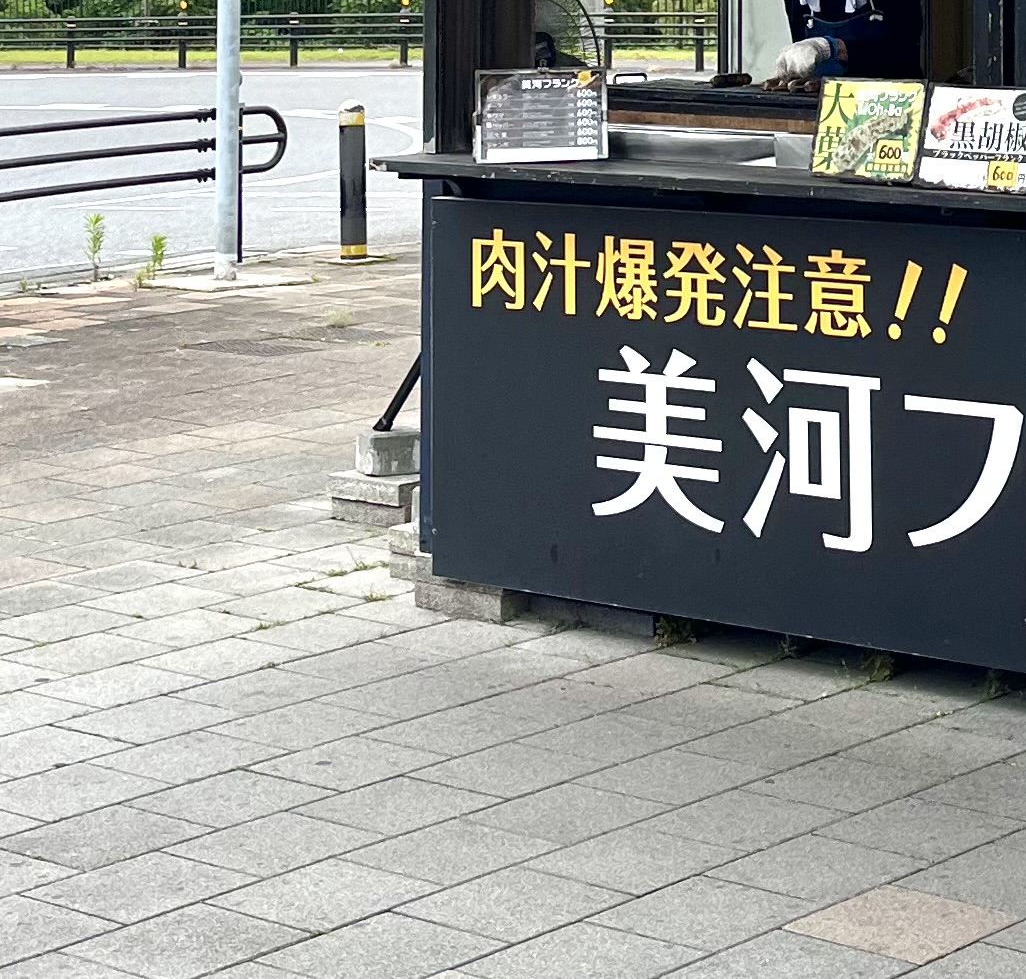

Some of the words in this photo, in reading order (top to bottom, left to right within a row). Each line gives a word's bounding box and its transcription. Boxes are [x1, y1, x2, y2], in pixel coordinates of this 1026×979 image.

[878, 144, 902, 160] 600
[992, 165, 1015, 181] 600
[471, 227, 968, 344] 肉汁爆発注意!!
